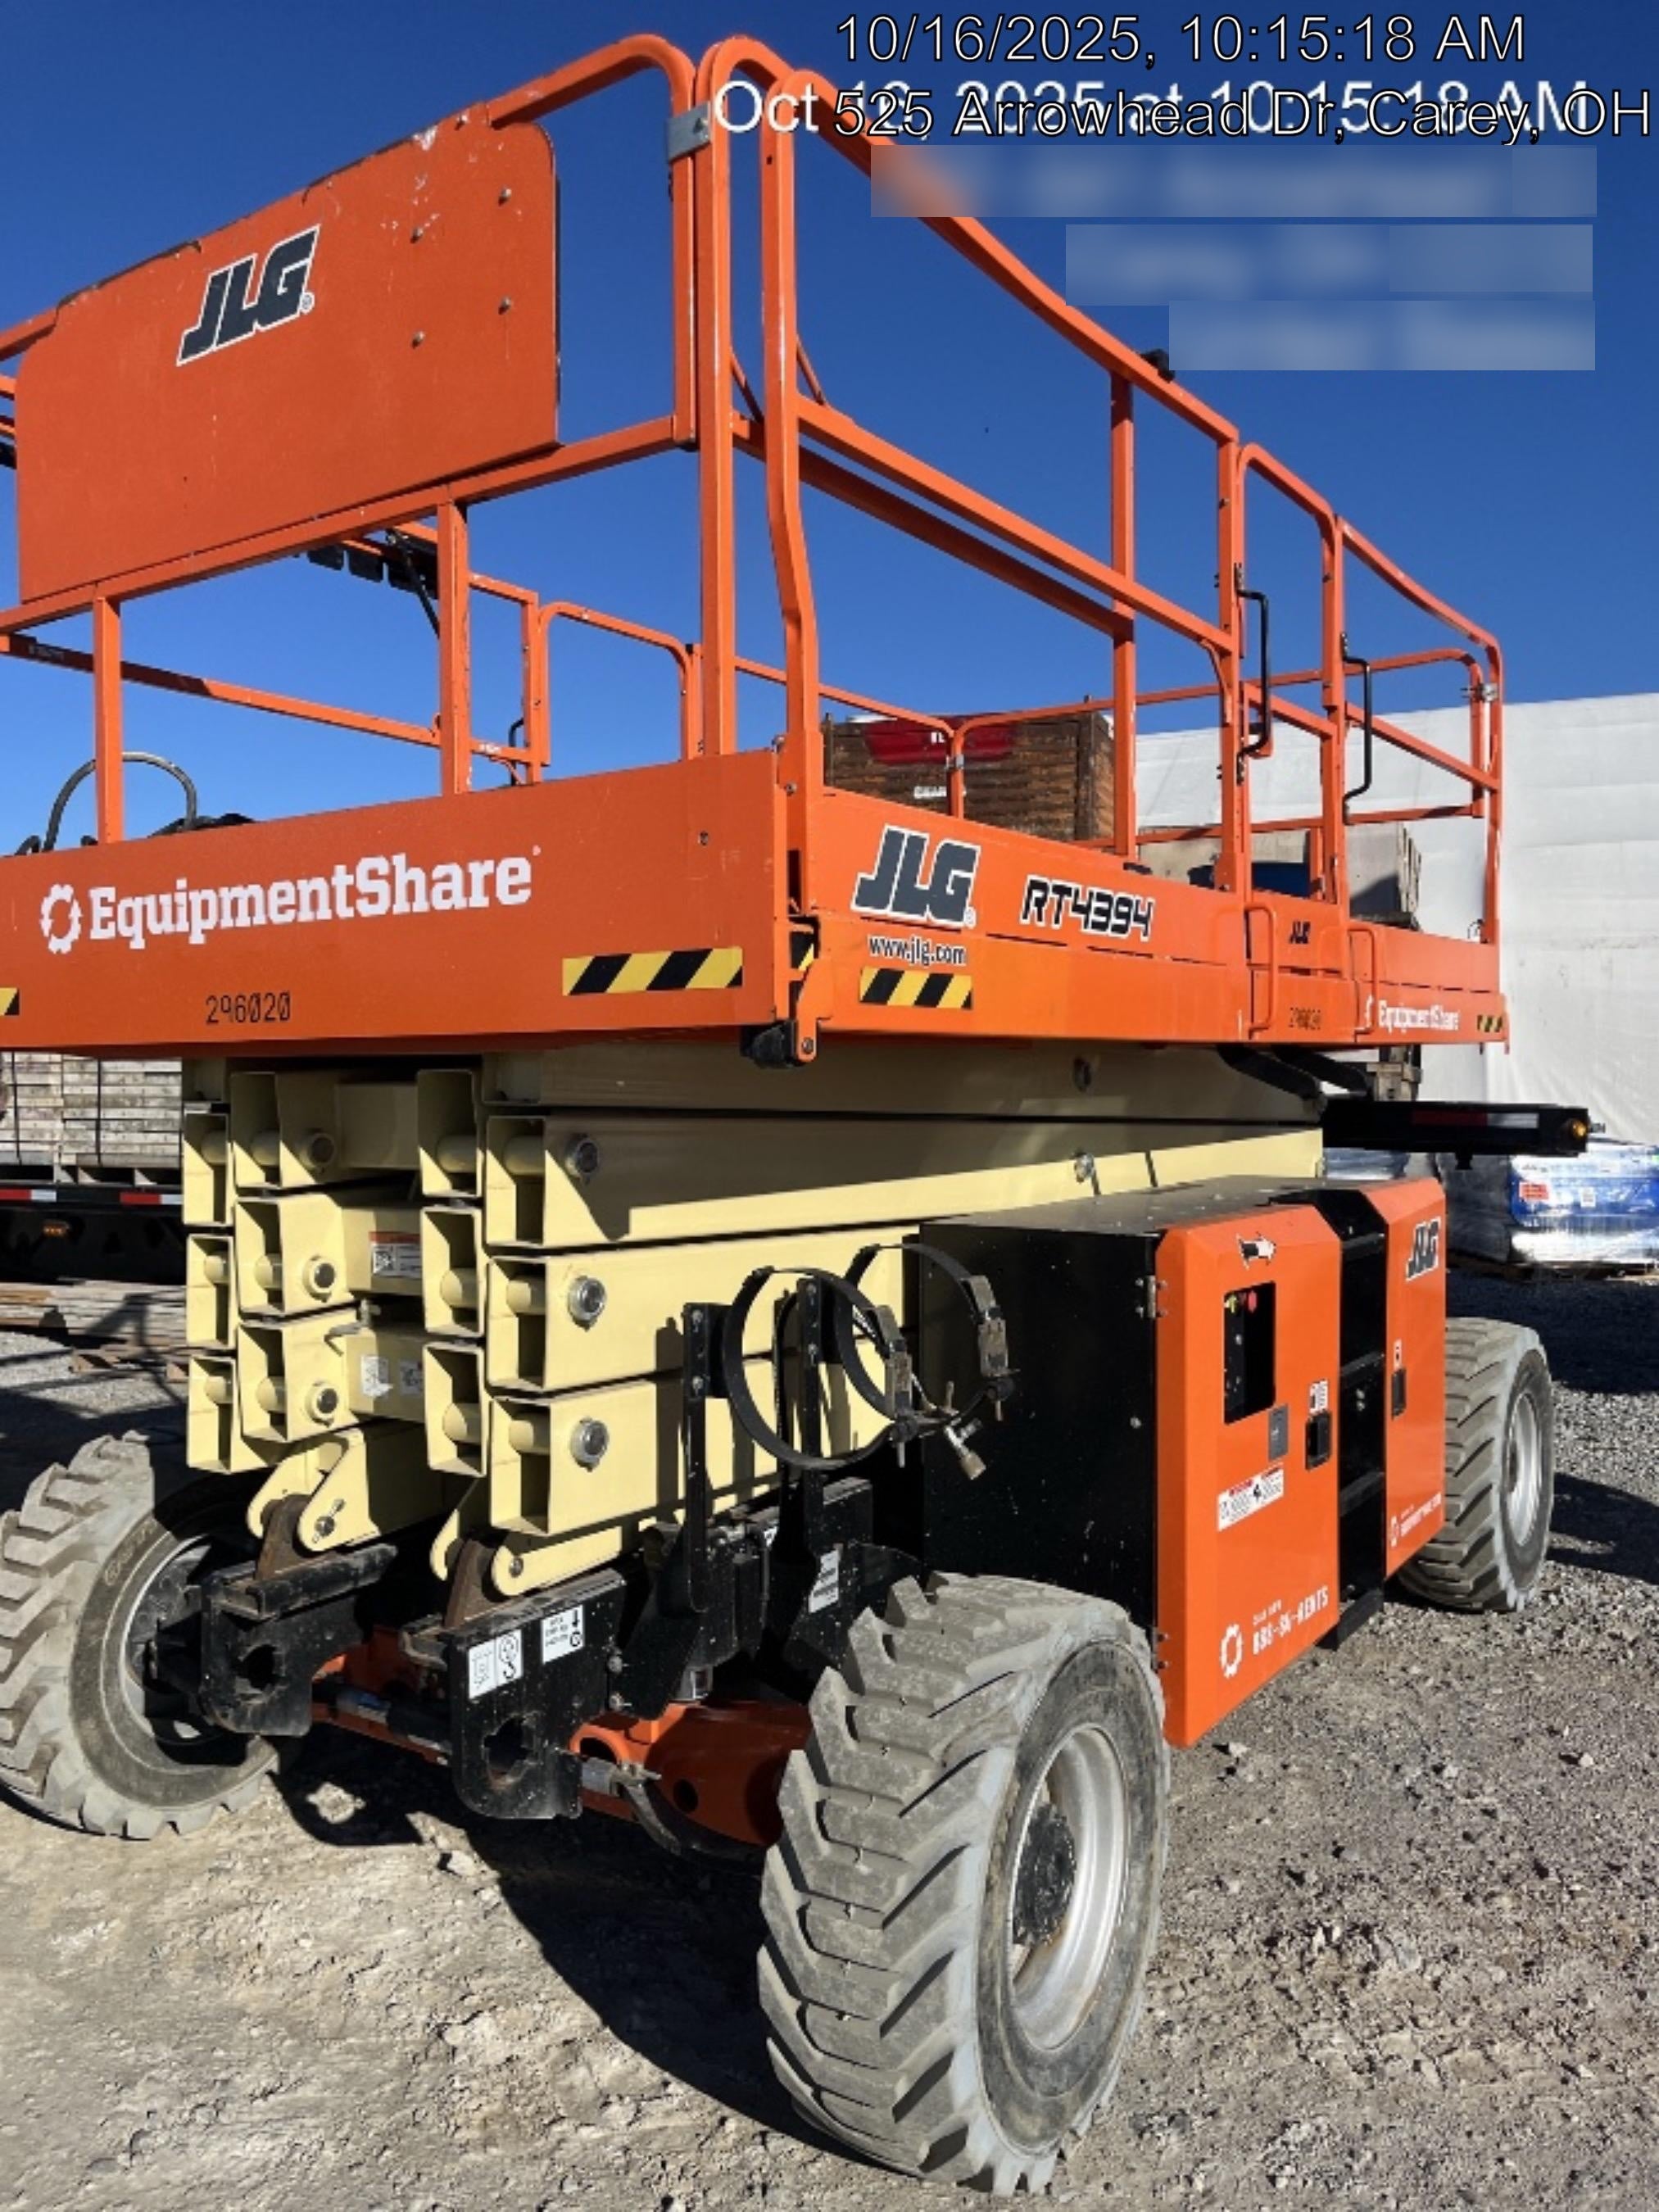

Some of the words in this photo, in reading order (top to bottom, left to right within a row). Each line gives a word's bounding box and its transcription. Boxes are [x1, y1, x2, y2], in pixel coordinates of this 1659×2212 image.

[175, 223, 322, 367] JLG
[88, 852, 533, 950] EquipmentShare
[850, 824, 981, 927] JLG
[1019, 874, 1155, 941] RT4394
[868, 936, 968, 968] www.jlg.com
[206, 990, 291, 1024] 296020
